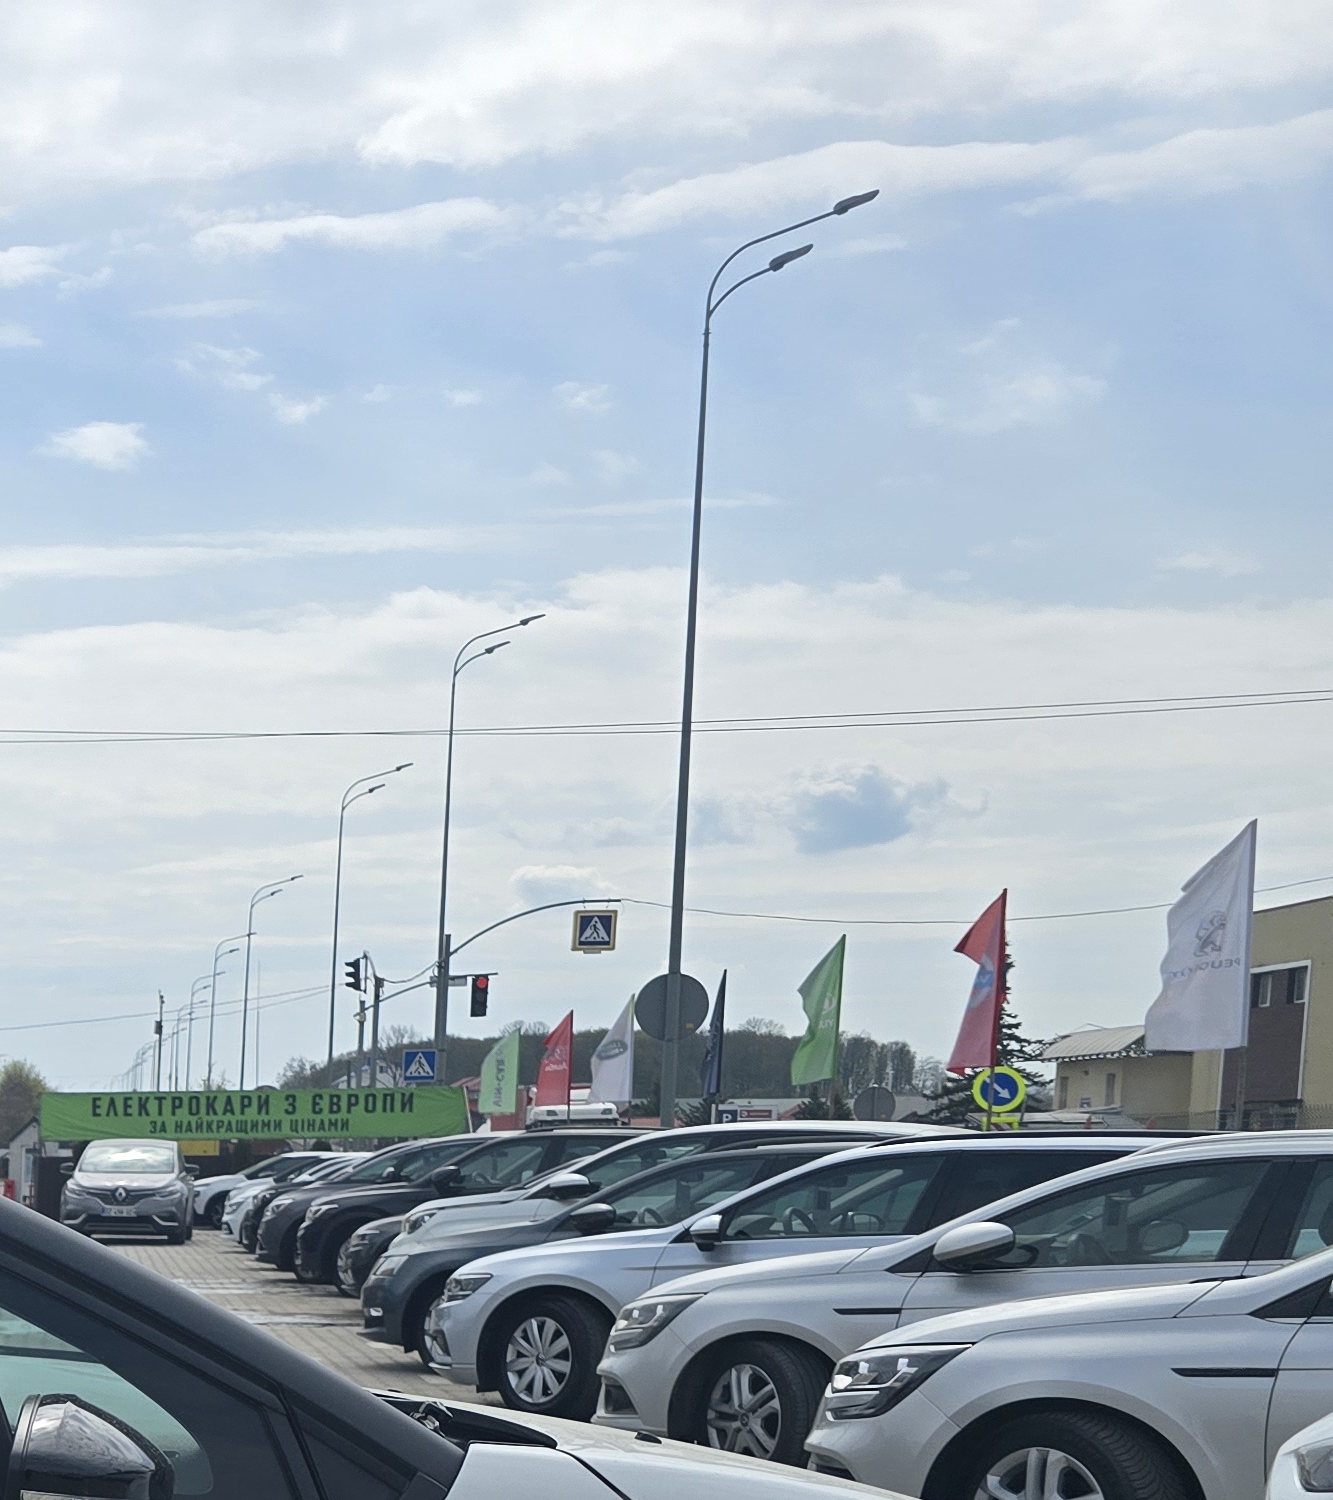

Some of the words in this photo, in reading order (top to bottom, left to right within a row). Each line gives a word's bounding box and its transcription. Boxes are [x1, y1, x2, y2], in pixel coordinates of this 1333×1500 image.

[91, 1094, 270, 1117] ЕЛЕКТРОКАРИ
[284, 1094, 297, 1115] З
[311, 1092, 414, 1115] ЄВРОПИ
[149, 1120, 167, 1134] ЗА
[174, 1117, 282, 1135] НАЙКРАЩИМИ
[290, 1118, 349, 1134] ЦІНАМИ
